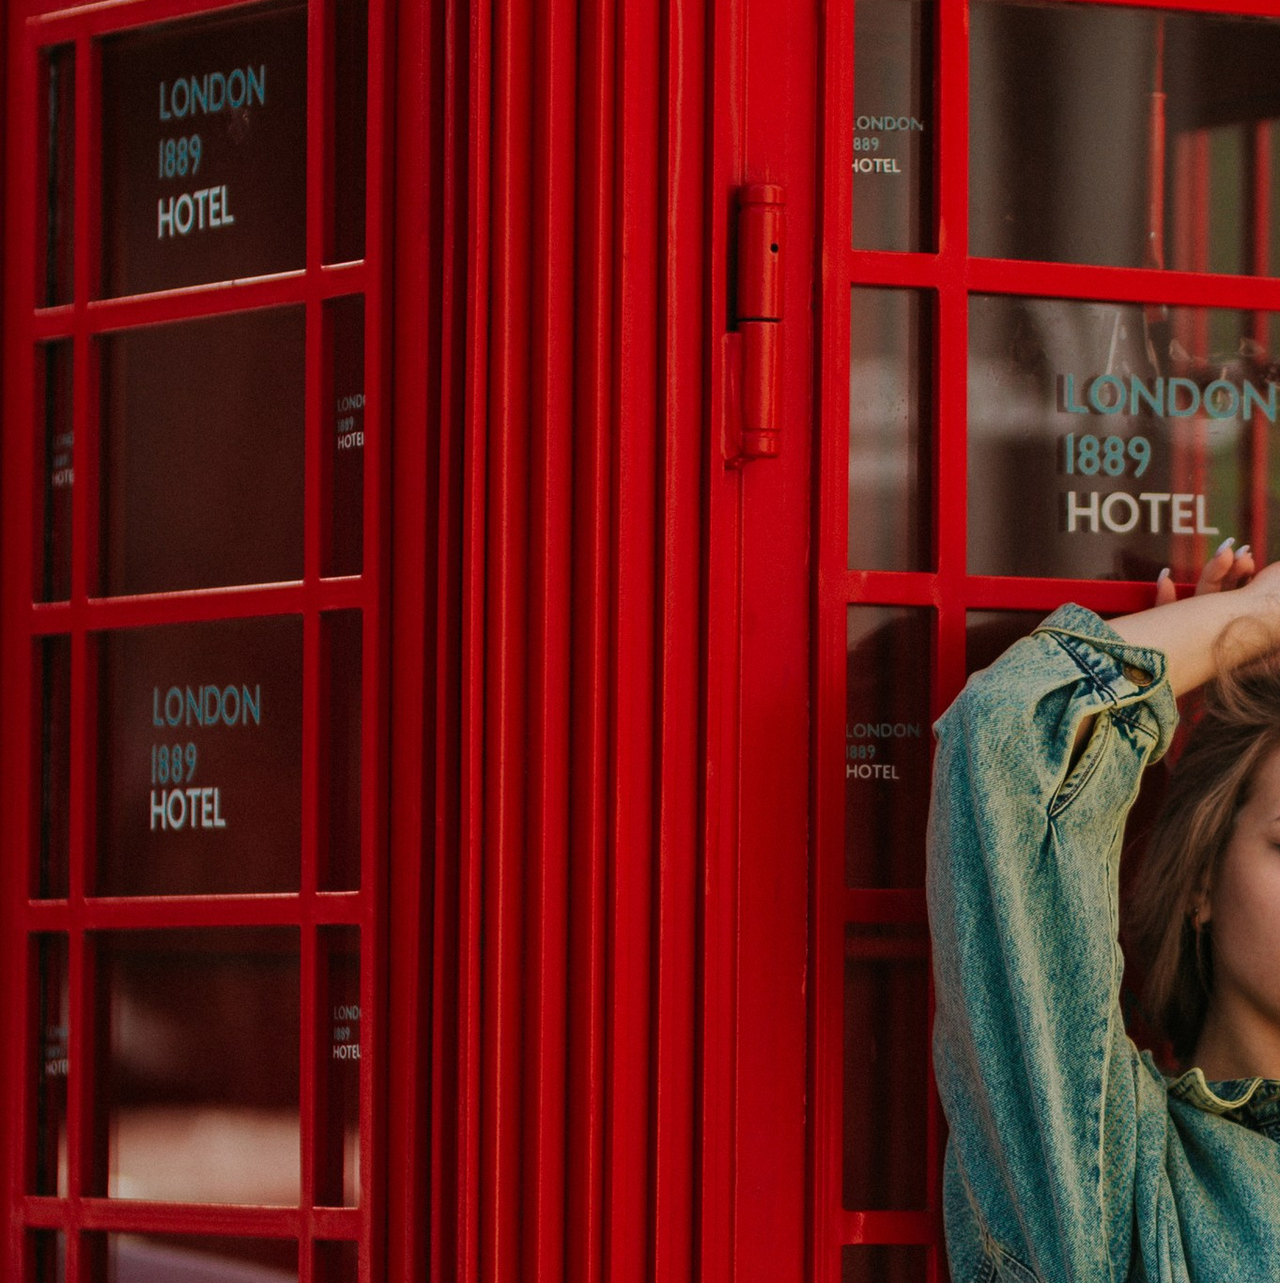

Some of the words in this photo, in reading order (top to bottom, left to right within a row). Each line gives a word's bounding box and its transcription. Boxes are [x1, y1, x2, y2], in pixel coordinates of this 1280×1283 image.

[159, 65, 266, 122] LONDON
[852, 116, 924, 131] ONDON
[852, 137, 880, 151] 889
[158, 134, 201, 179] 1889
[157, 184, 234, 239] HOTEL
[337, 394, 365, 412] LOND
[1066, 373, 1277, 422] LONDON
[1066, 432, 1151, 477] 1889
[1067, 491, 1219, 535] HOTEL
[152, 684, 261, 727] LONDON
[846, 723, 920, 738] LONDON
[151, 743, 198, 784] 1889
[846, 764, 899, 779] HOTEL
[150, 787, 226, 830] HOTEL
[333, 1005, 361, 1020] LOND
